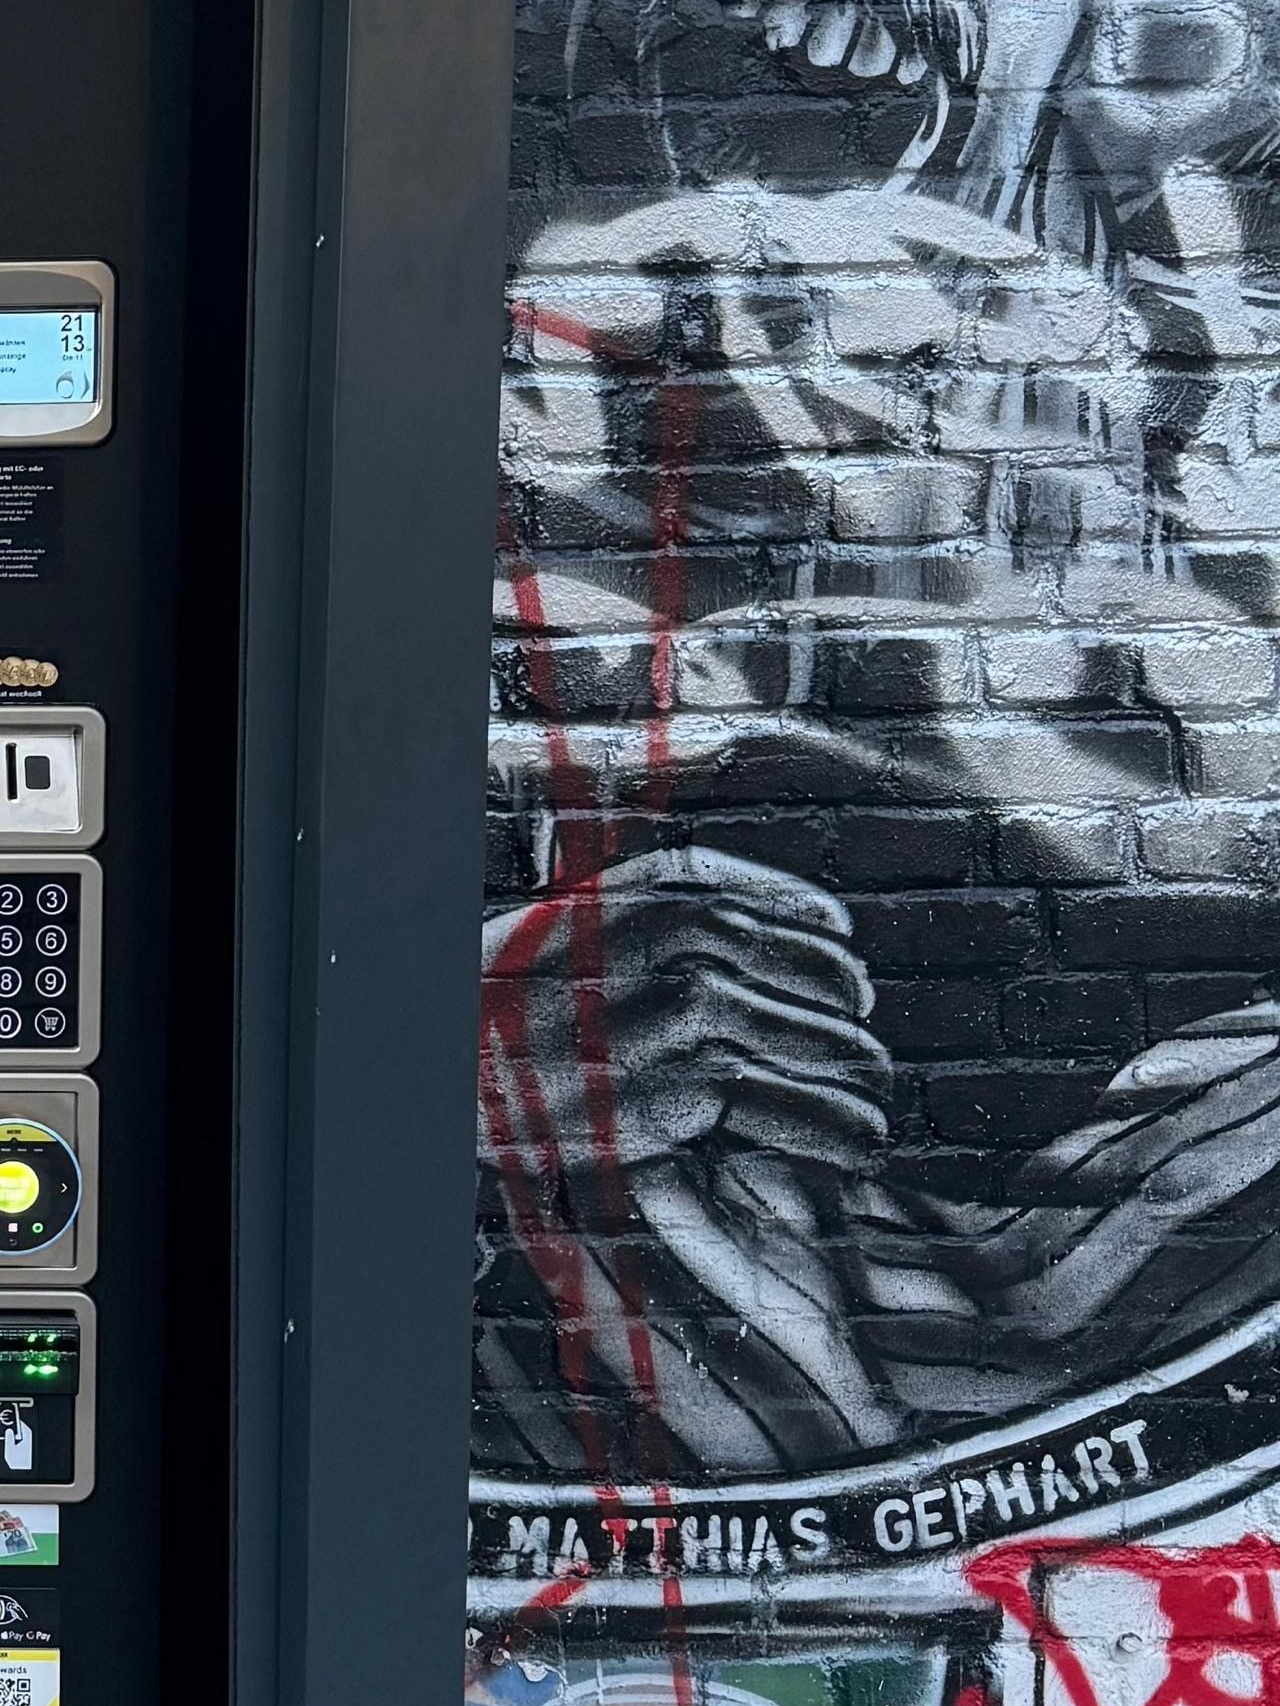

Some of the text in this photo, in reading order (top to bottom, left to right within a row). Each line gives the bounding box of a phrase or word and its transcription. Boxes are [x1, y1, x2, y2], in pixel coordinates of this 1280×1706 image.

[61, 315, 82, 332] 21
[61, 335, 85, 352] 13
[1, 892, 14, 908] 2
[46, 892, 58, 908] 3
[0, 933, 12, 949] 5
[45, 933, 57, 949] 6
[0, 974, 12, 990] 8
[45, 974, 57, 990] 9
[0, 1015, 12, 1031] 0
[508, 1419, 1150, 1577] MATTHIAS GEPHART
[9, 1631, 24, 1642] Pay
[36, 1632, 51, 1641] Pay
